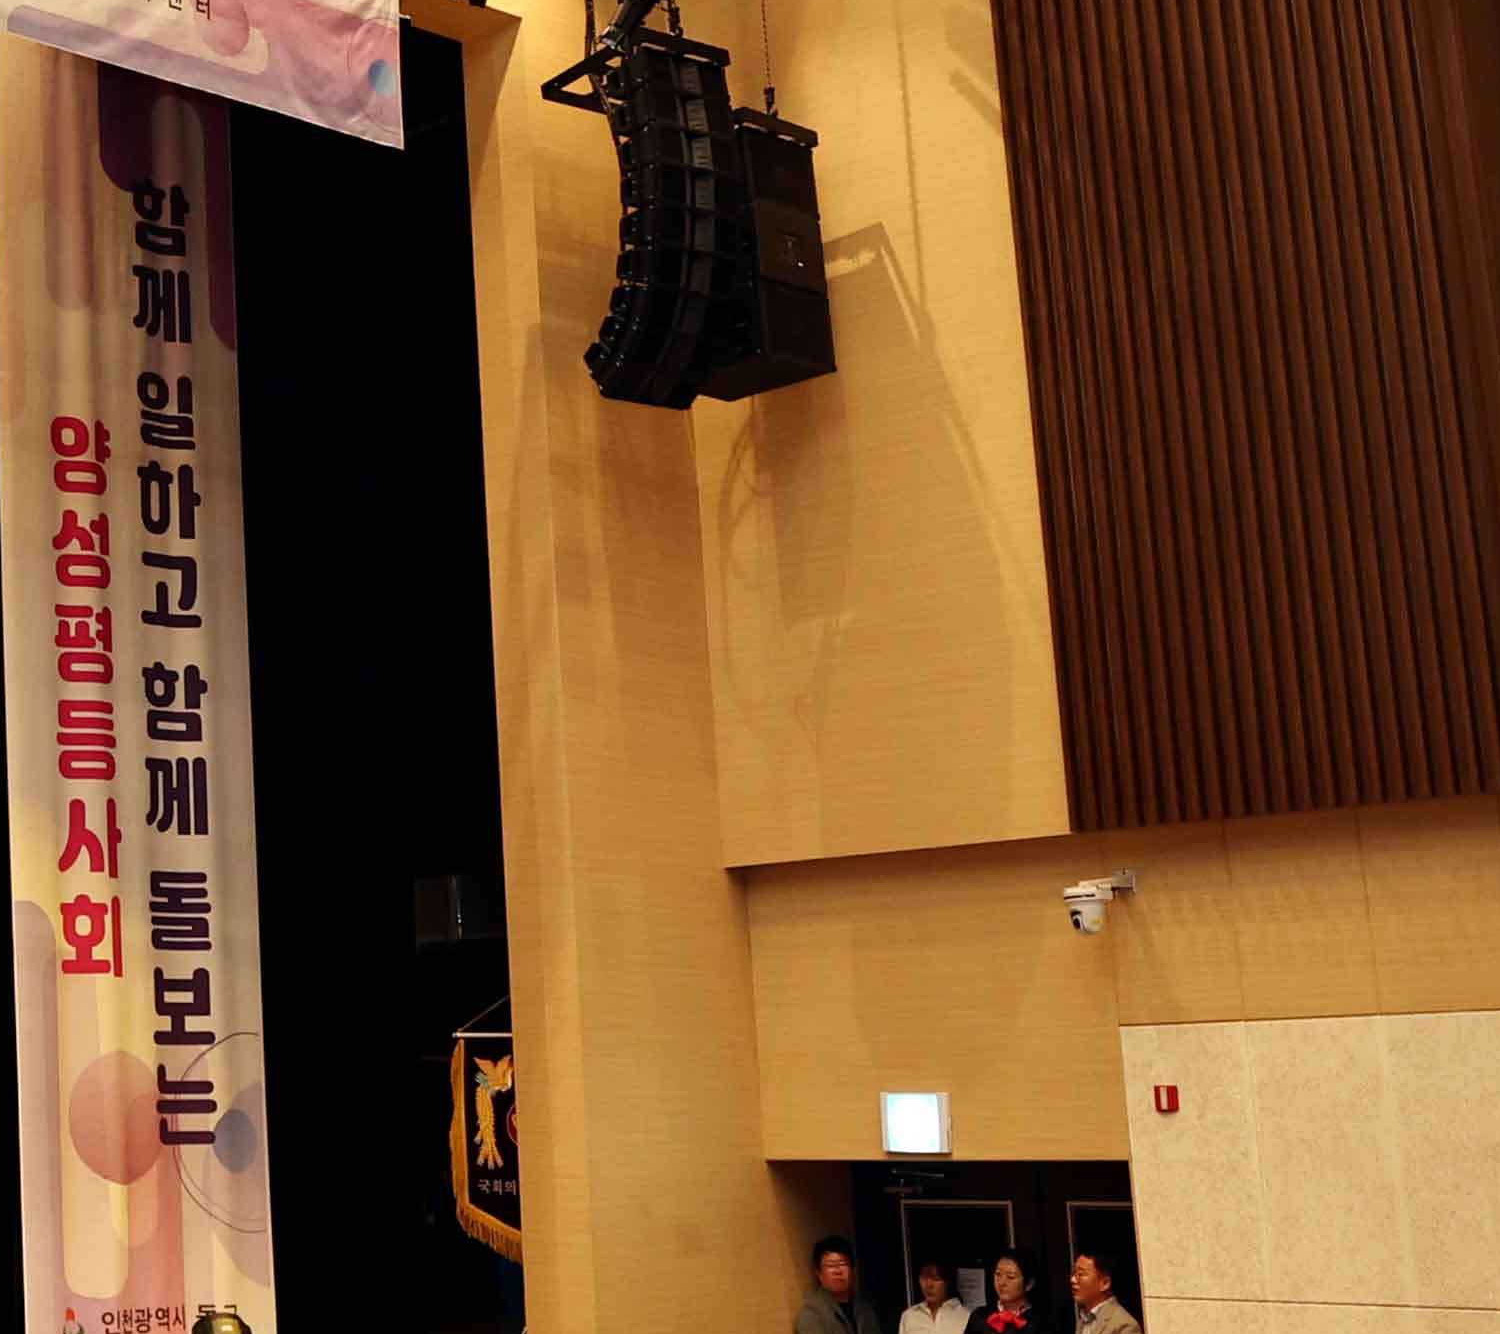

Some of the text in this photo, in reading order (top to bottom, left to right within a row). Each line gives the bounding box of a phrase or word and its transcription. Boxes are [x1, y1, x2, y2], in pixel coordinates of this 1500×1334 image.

[131, 178, 218, 1147] 함께 일하고 함께 돌보는
